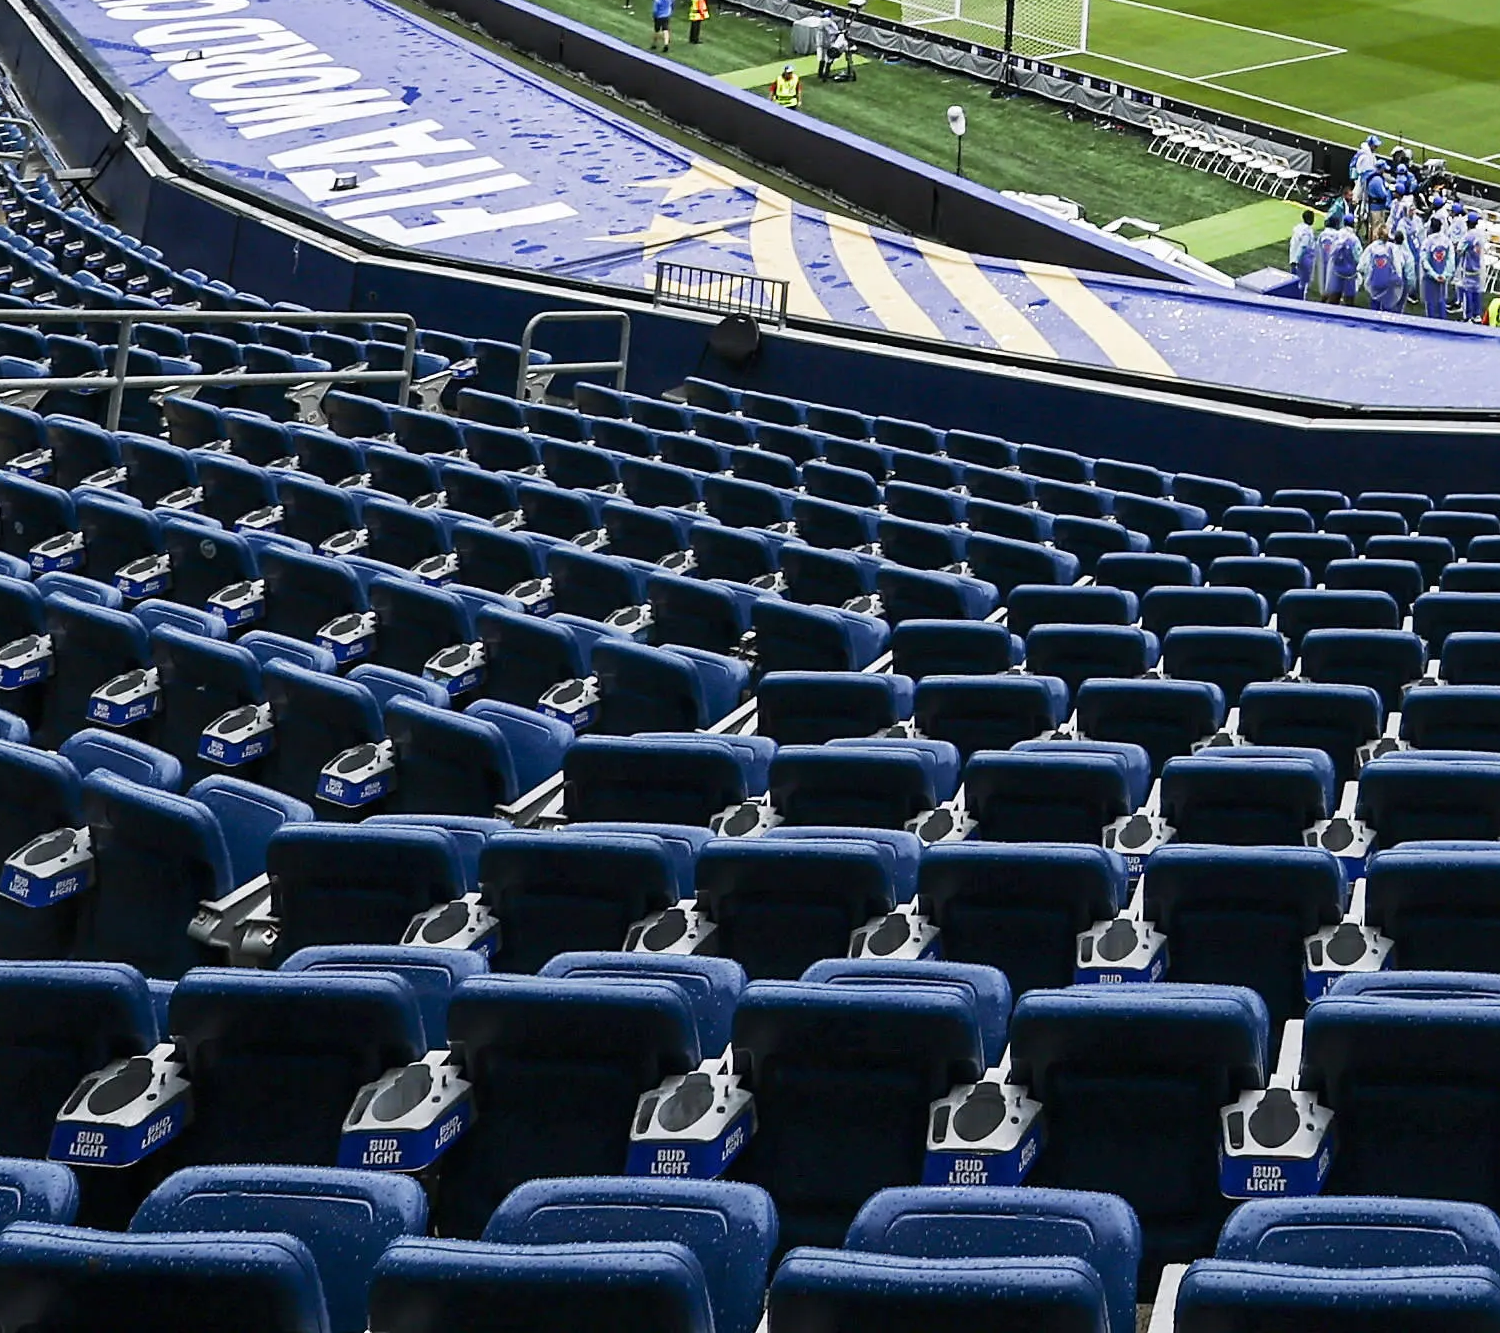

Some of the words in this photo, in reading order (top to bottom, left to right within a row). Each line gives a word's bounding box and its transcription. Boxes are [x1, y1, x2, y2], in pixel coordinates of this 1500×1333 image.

[132, 18, 411, 140] WORLD
[267, 119, 579, 247] FIFA
[12, 874, 29, 888] BUD
[9, 882, 29, 898] LIGHT
[148, 1115, 169, 1134] BUD
[440, 1115, 459, 1134] BUD
[77, 1131, 103, 1144] BUD
[141, 1120, 172, 1149] LIGHT
[435, 1120, 462, 1149] LIGHT
[69, 1142, 107, 1158] LIGHT
[370, 1139, 398, 1152] BUD
[362, 1151, 401, 1165] LIGHT
[657, 1149, 685, 1163] BUD
[651, 1162, 690, 1175] LIGHT
[955, 1159, 983, 1173] BUD
[1252, 1165, 1280, 1179] BUD
[950, 1172, 988, 1186] LIGHT
[1246, 1178, 1286, 1192] LIGHT
